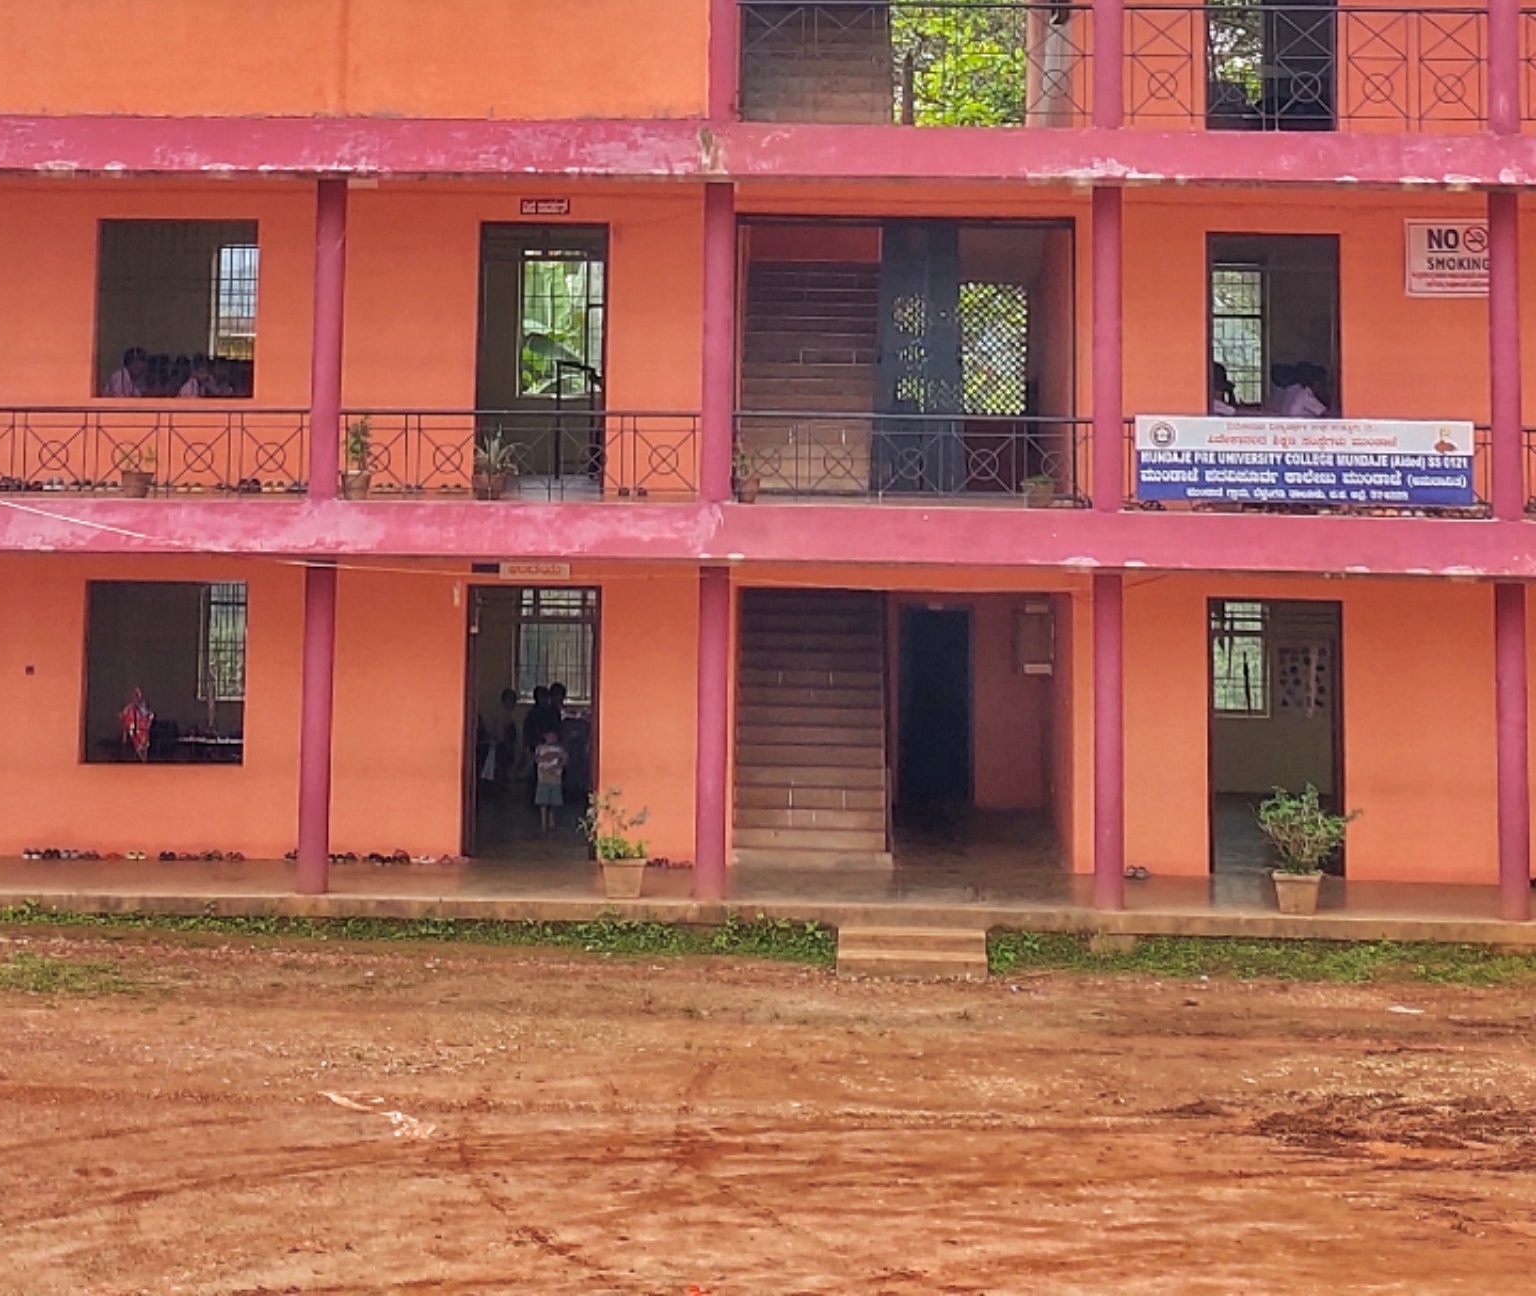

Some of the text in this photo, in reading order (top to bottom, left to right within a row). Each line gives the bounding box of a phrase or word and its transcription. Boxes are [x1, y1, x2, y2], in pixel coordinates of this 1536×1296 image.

[1427, 229, 1459, 249] NO
[1427, 257, 1490, 270] SMOKING
[1141, 451, 1192, 464] MUNDAJE
[1194, 452, 1215, 464] PRE
[1218, 452, 1283, 465] UNIVERSITY
[1285, 453, 1334, 466] COLLEGE
[1337, 455, 1388, 467] MUNDAJE
